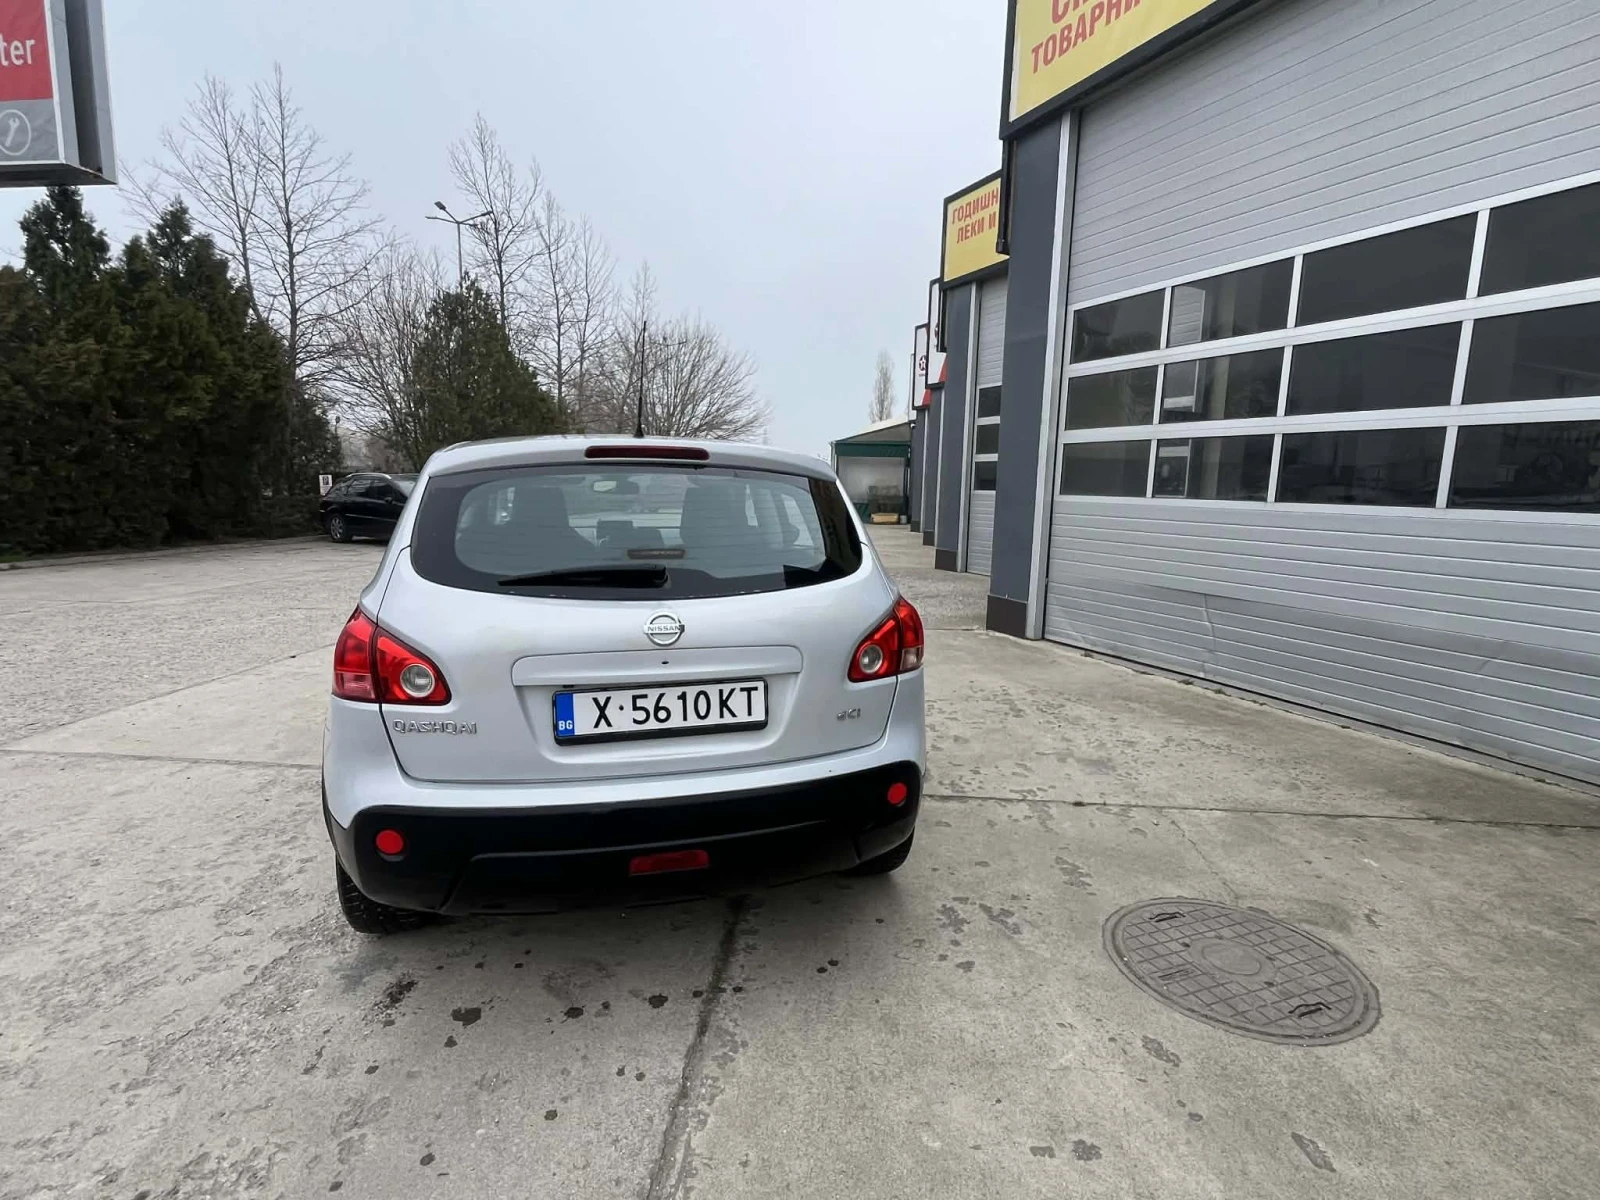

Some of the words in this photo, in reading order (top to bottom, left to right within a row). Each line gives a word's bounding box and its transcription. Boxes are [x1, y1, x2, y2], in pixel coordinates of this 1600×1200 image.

[952, 187, 999, 225] ГОДИШН
[957, 216, 985, 244] ЛЕКИ
[393, 719, 478, 735] QASHQAI
[558, 720, 573, 731] BG
